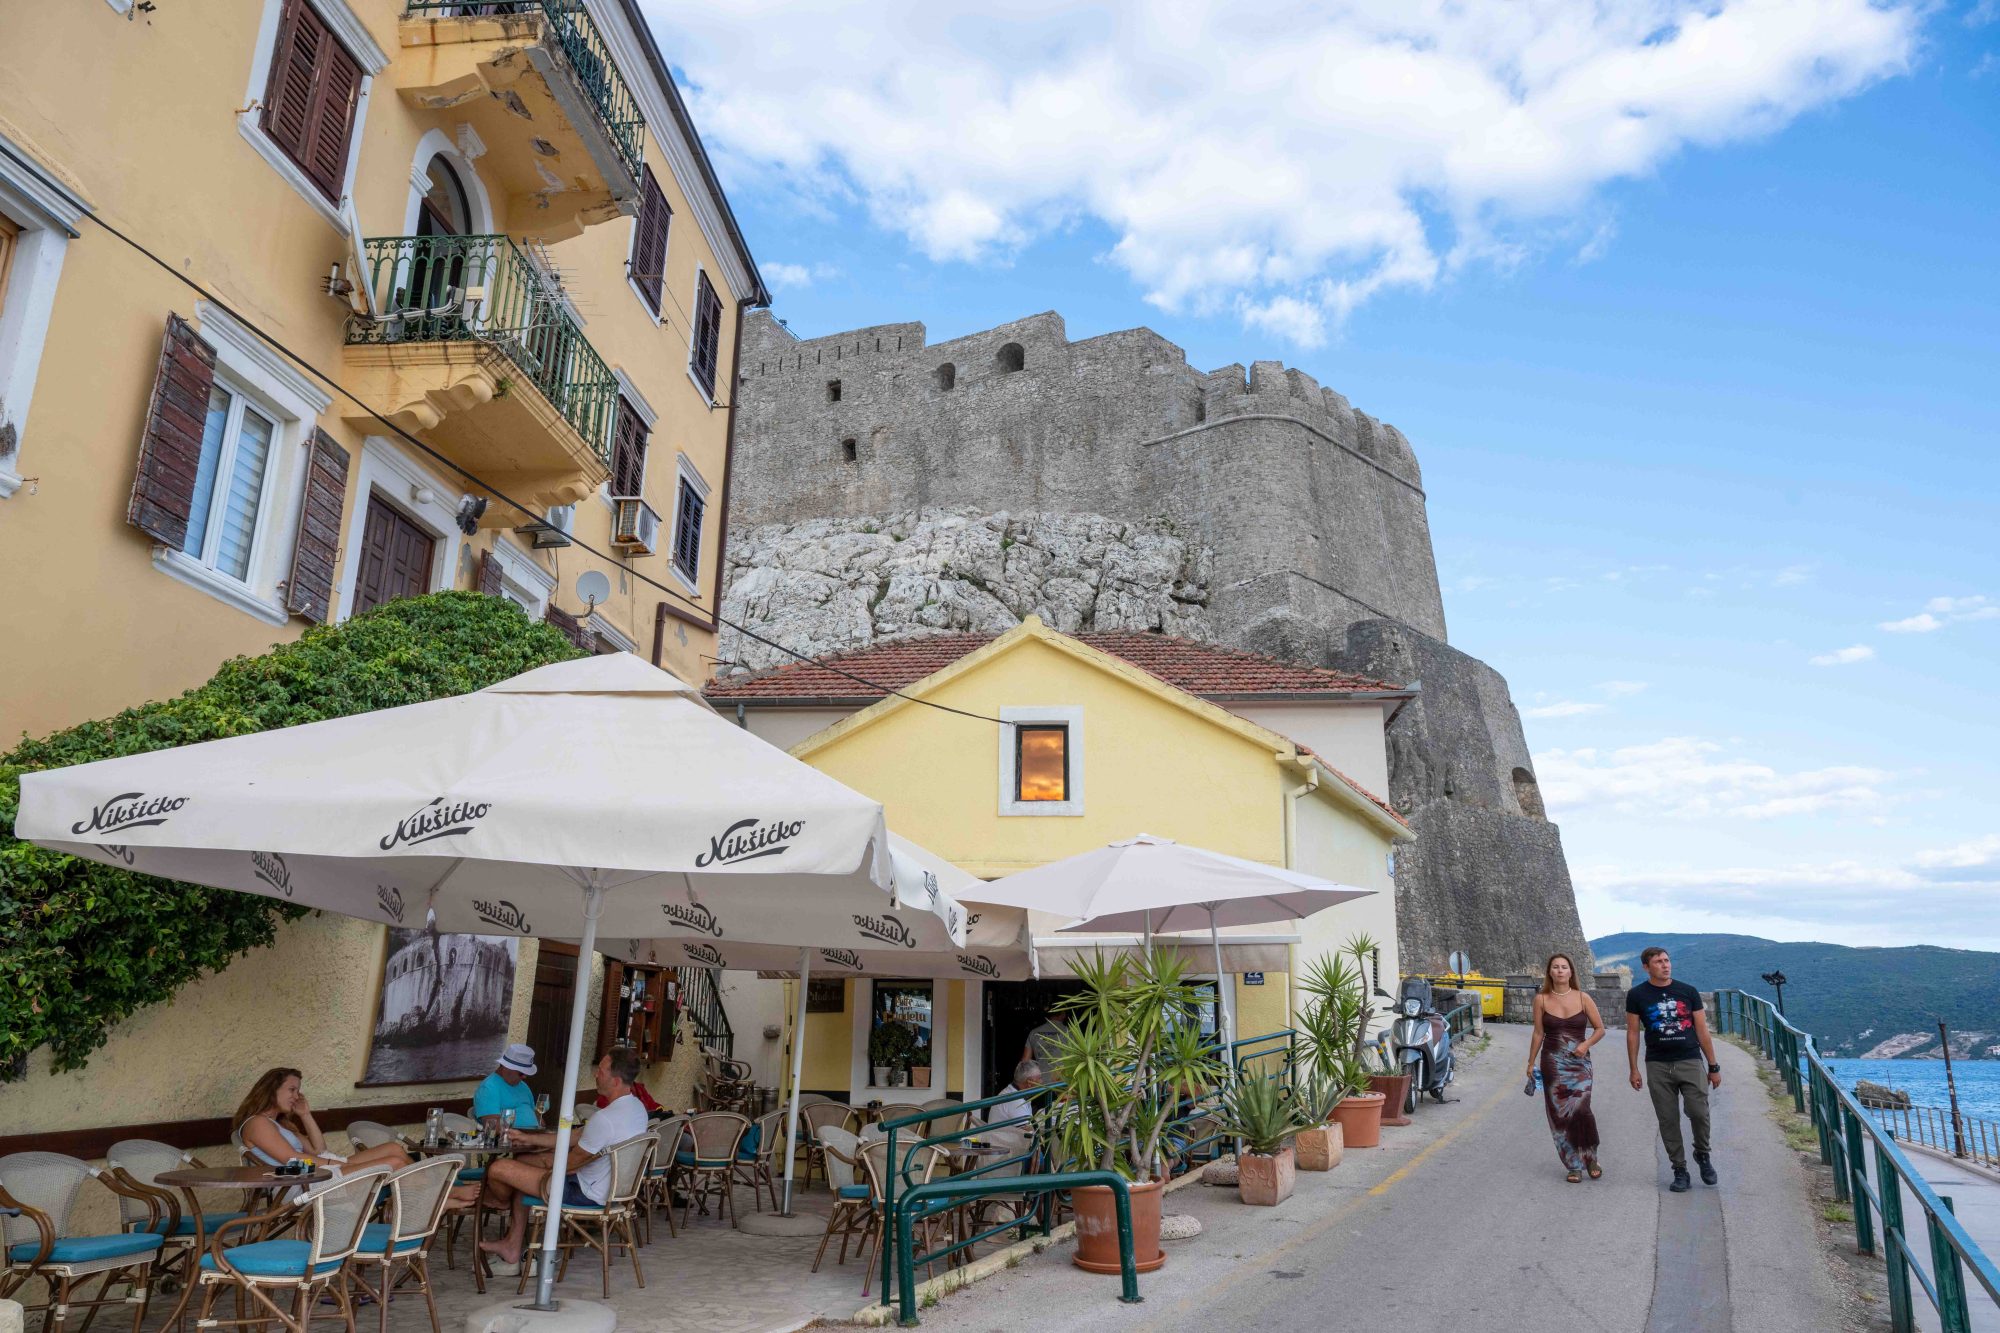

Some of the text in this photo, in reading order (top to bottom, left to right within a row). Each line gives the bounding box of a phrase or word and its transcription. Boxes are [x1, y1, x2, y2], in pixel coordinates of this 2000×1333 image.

[72, 792, 187, 835] Nikšićko
[380, 797, 488, 850] Nikšićko
[695, 818, 802, 868] Nikšićko
